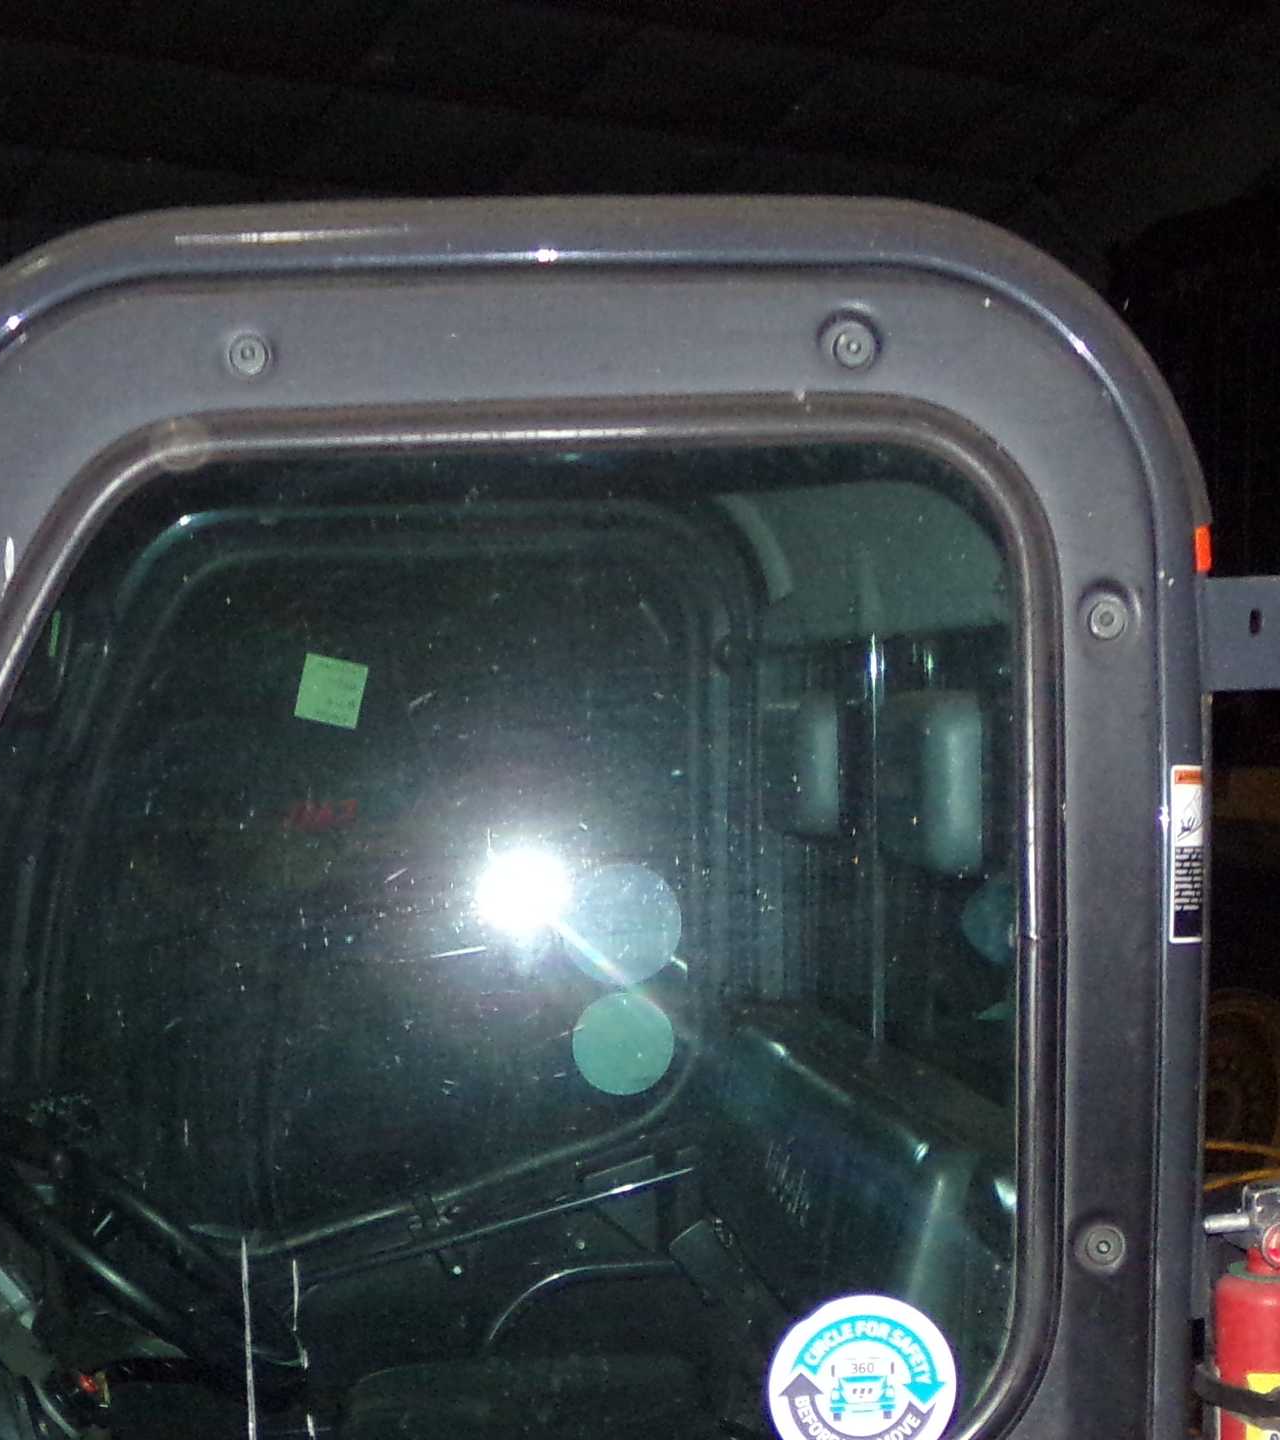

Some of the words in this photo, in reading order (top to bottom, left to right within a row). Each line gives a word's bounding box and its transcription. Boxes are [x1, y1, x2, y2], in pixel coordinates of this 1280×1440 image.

[804, 1324, 853, 1366] CIRCLE
[855, 1319, 890, 1338] FOR
[891, 1328, 933, 1384] SAFETY
[851, 1363, 875, 1374] 360
